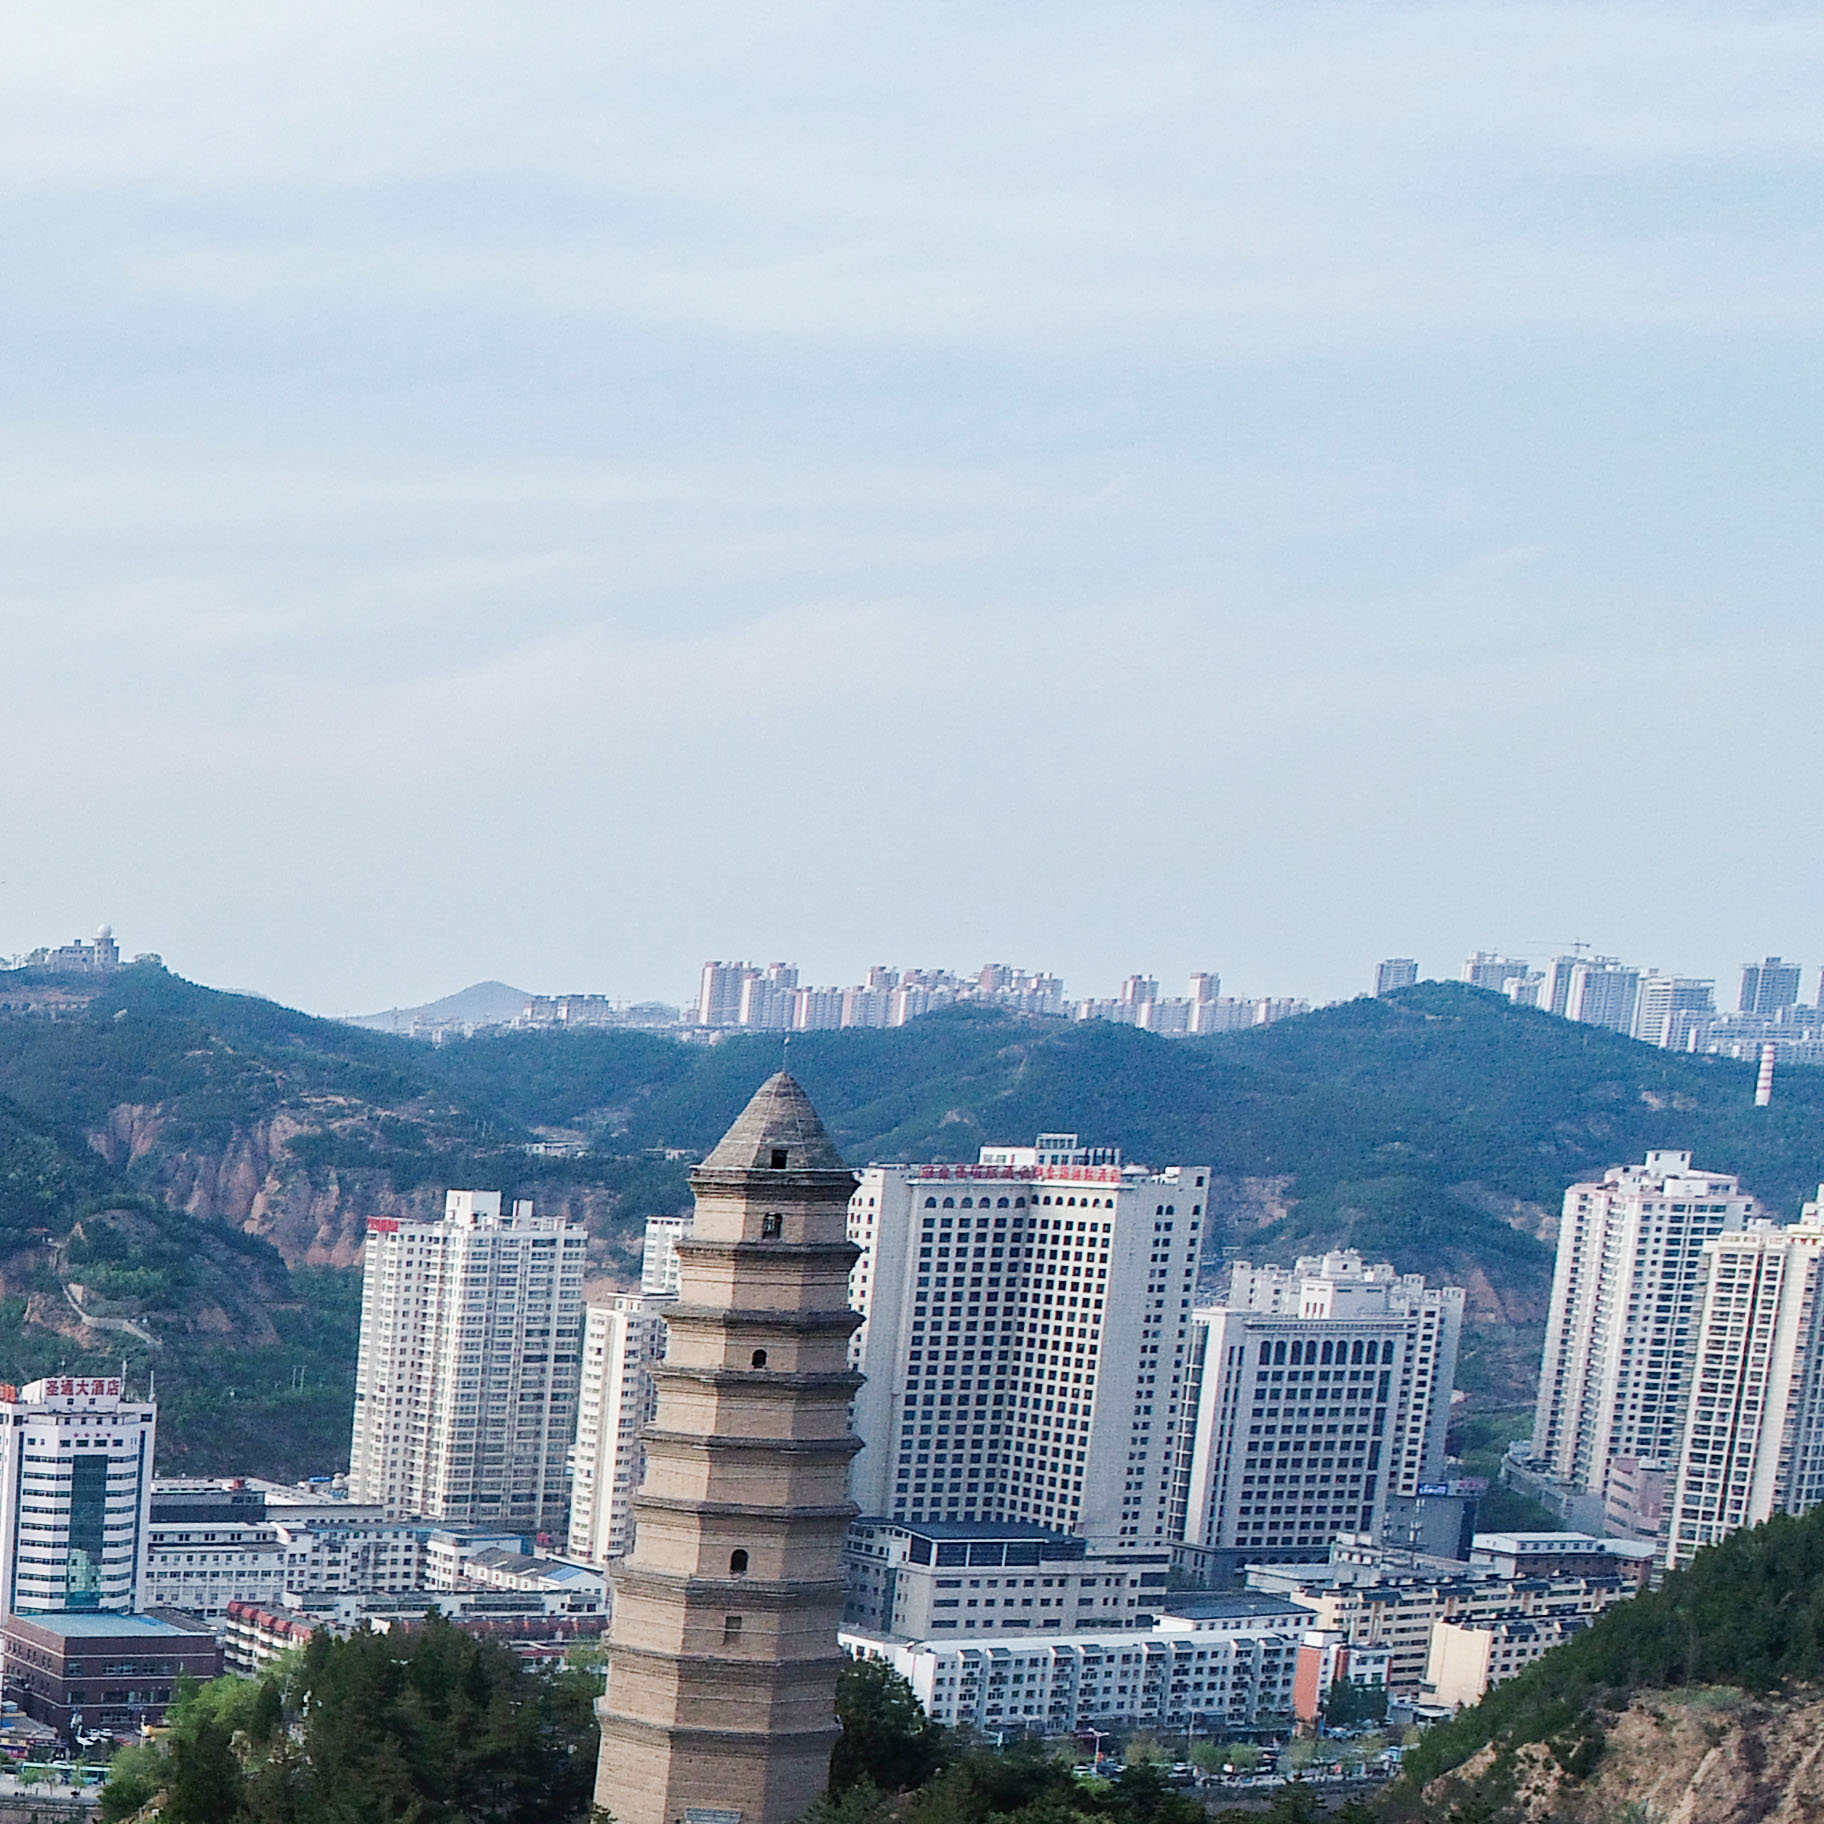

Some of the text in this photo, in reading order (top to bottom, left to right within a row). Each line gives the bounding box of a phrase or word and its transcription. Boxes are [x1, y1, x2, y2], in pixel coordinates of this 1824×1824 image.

[46, 1379, 120, 1396] 圣通大酒店
